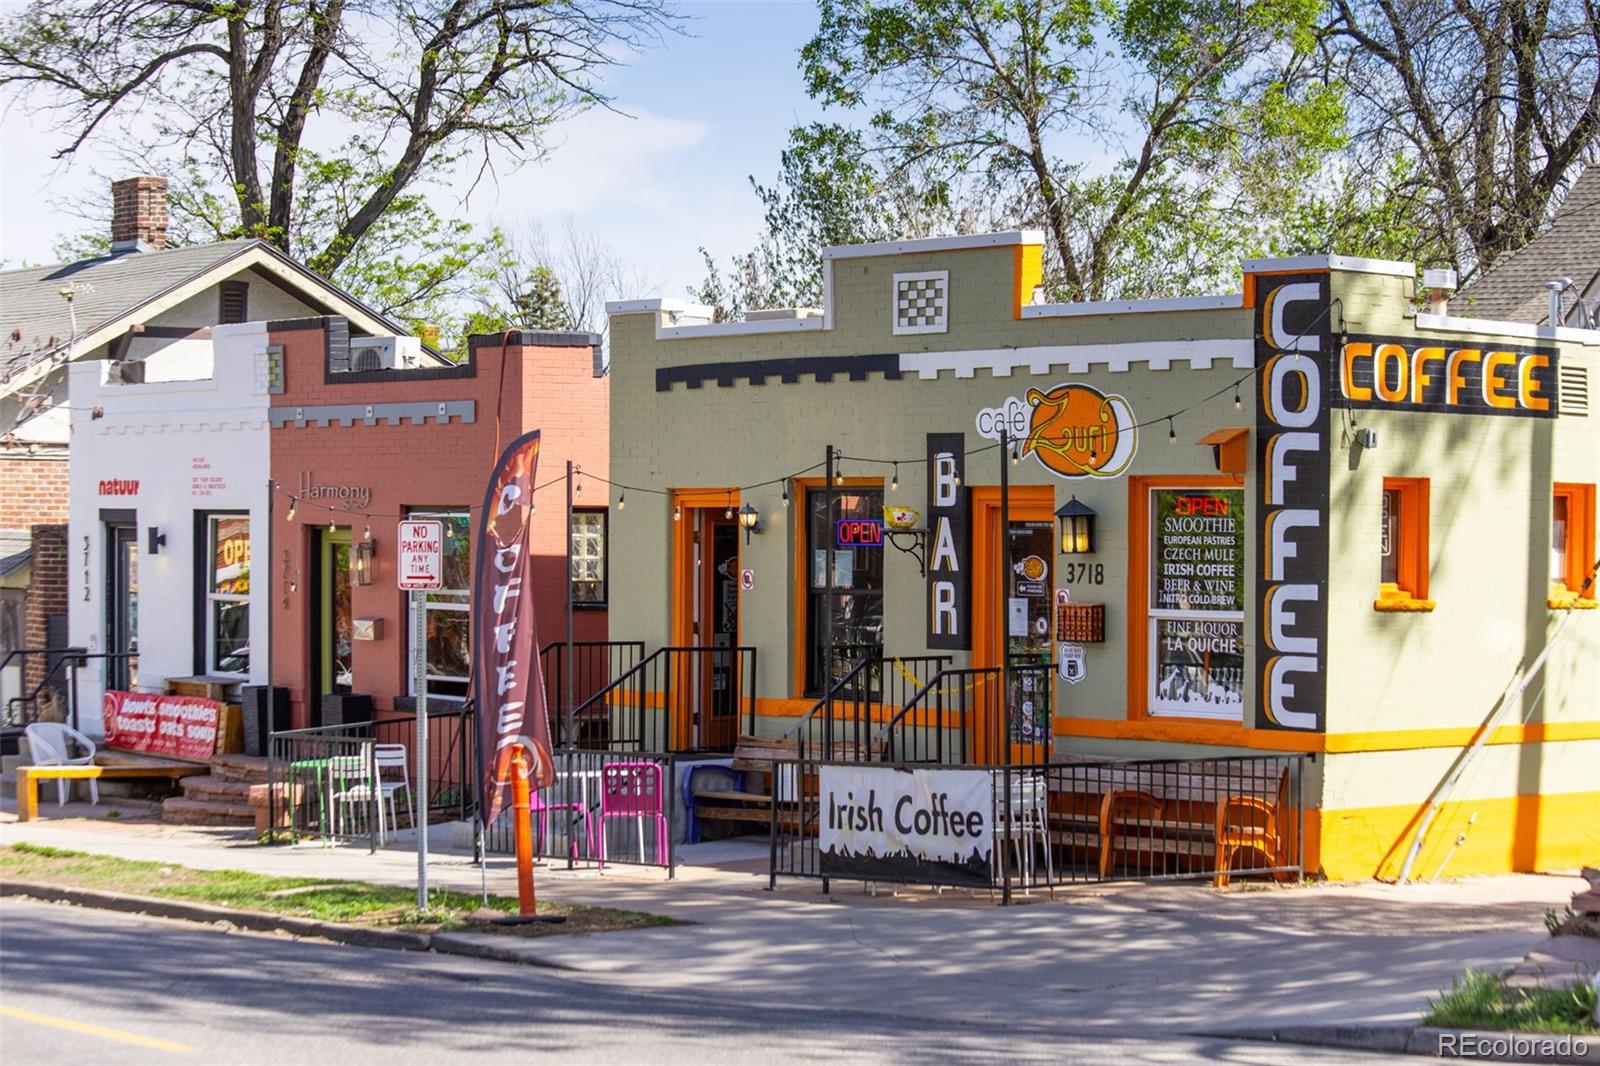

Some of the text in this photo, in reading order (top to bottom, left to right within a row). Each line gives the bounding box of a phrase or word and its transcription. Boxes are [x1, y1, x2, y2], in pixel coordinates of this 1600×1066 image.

[1340, 342, 1550, 411] COFFEE
[98, 478, 140, 496] natuur
[300, 471, 369, 508] Harmony
[1176, 496, 1229, 515] OPEN
[1264, 282, 1321, 730] COFFEE
[413, 526, 428, 538] NO
[839, 523, 880, 543] OPEN
[1164, 517, 1236, 533] SMOOTHIE
[402, 540, 439, 553] PARKING
[930, 452, 958, 635] BAR
[1163, 535, 1236, 545] EUROPEAN PASTRIES
[412, 555, 428, 563] ANY
[1163, 547, 1235, 561] CZECH MULE
[411, 564, 430, 573] TIME
[1066, 562, 1104, 585] 3718
[1163, 563, 1235, 577] IRISH COFFEE
[1163, 579, 1235, 592] BEER & WINE
[1163, 594, 1236, 605] NITRO COLD BREW
[1167, 621, 1238, 637] FINE LIQUOR
[1167, 637, 1237, 653] LA QUICHE
[121, 698, 216, 722] bowls smoothies
[116, 715, 216, 742] toasts oats soup
[829, 789, 984, 838] Irish Coffee
